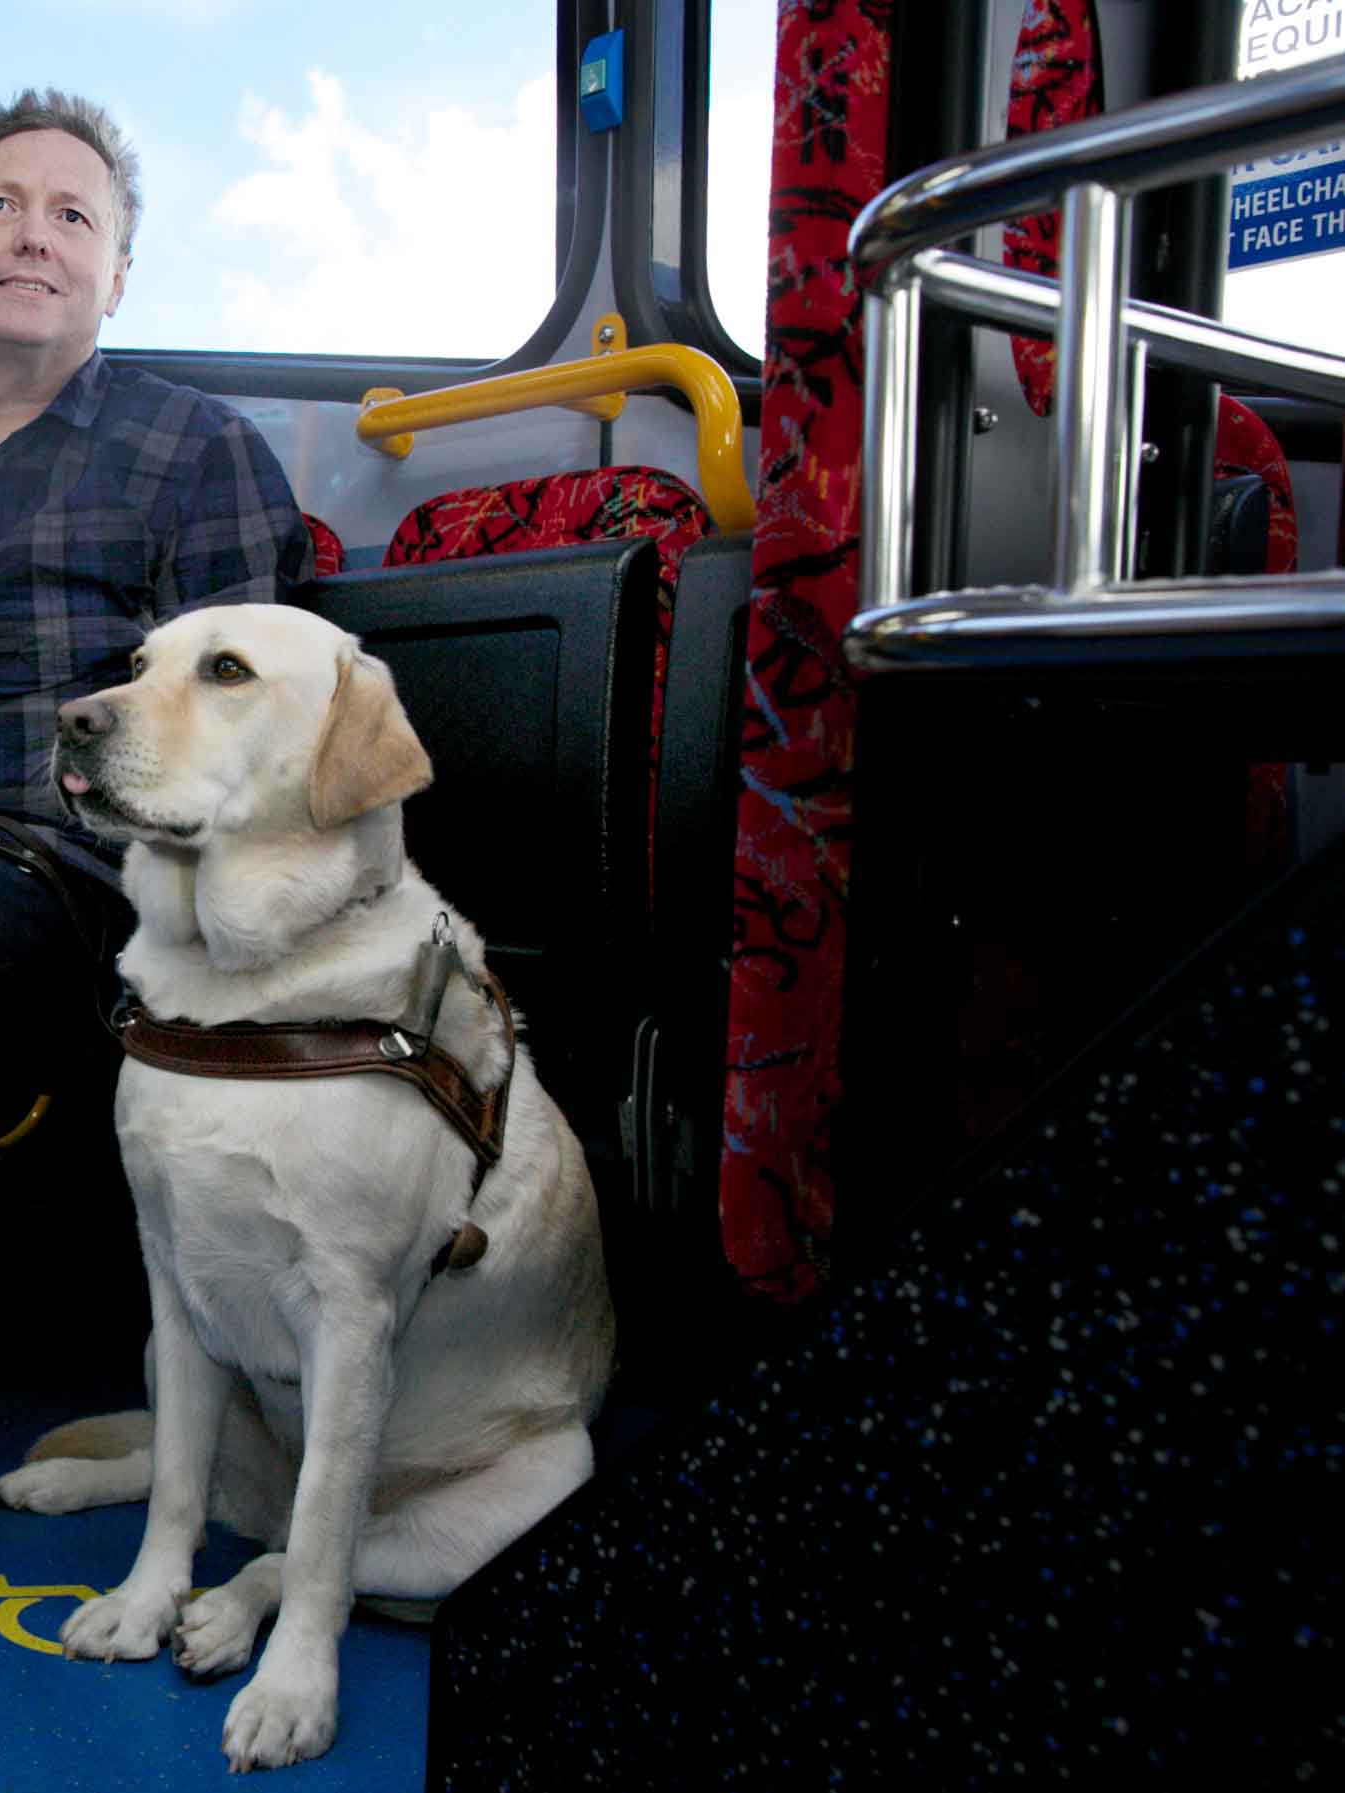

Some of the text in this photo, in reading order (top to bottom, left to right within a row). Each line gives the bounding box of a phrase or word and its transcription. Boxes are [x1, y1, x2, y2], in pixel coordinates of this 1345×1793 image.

[1231, 173, 1345, 220] HEELCHA
[1242, 208, 1345, 253] FACE TH
